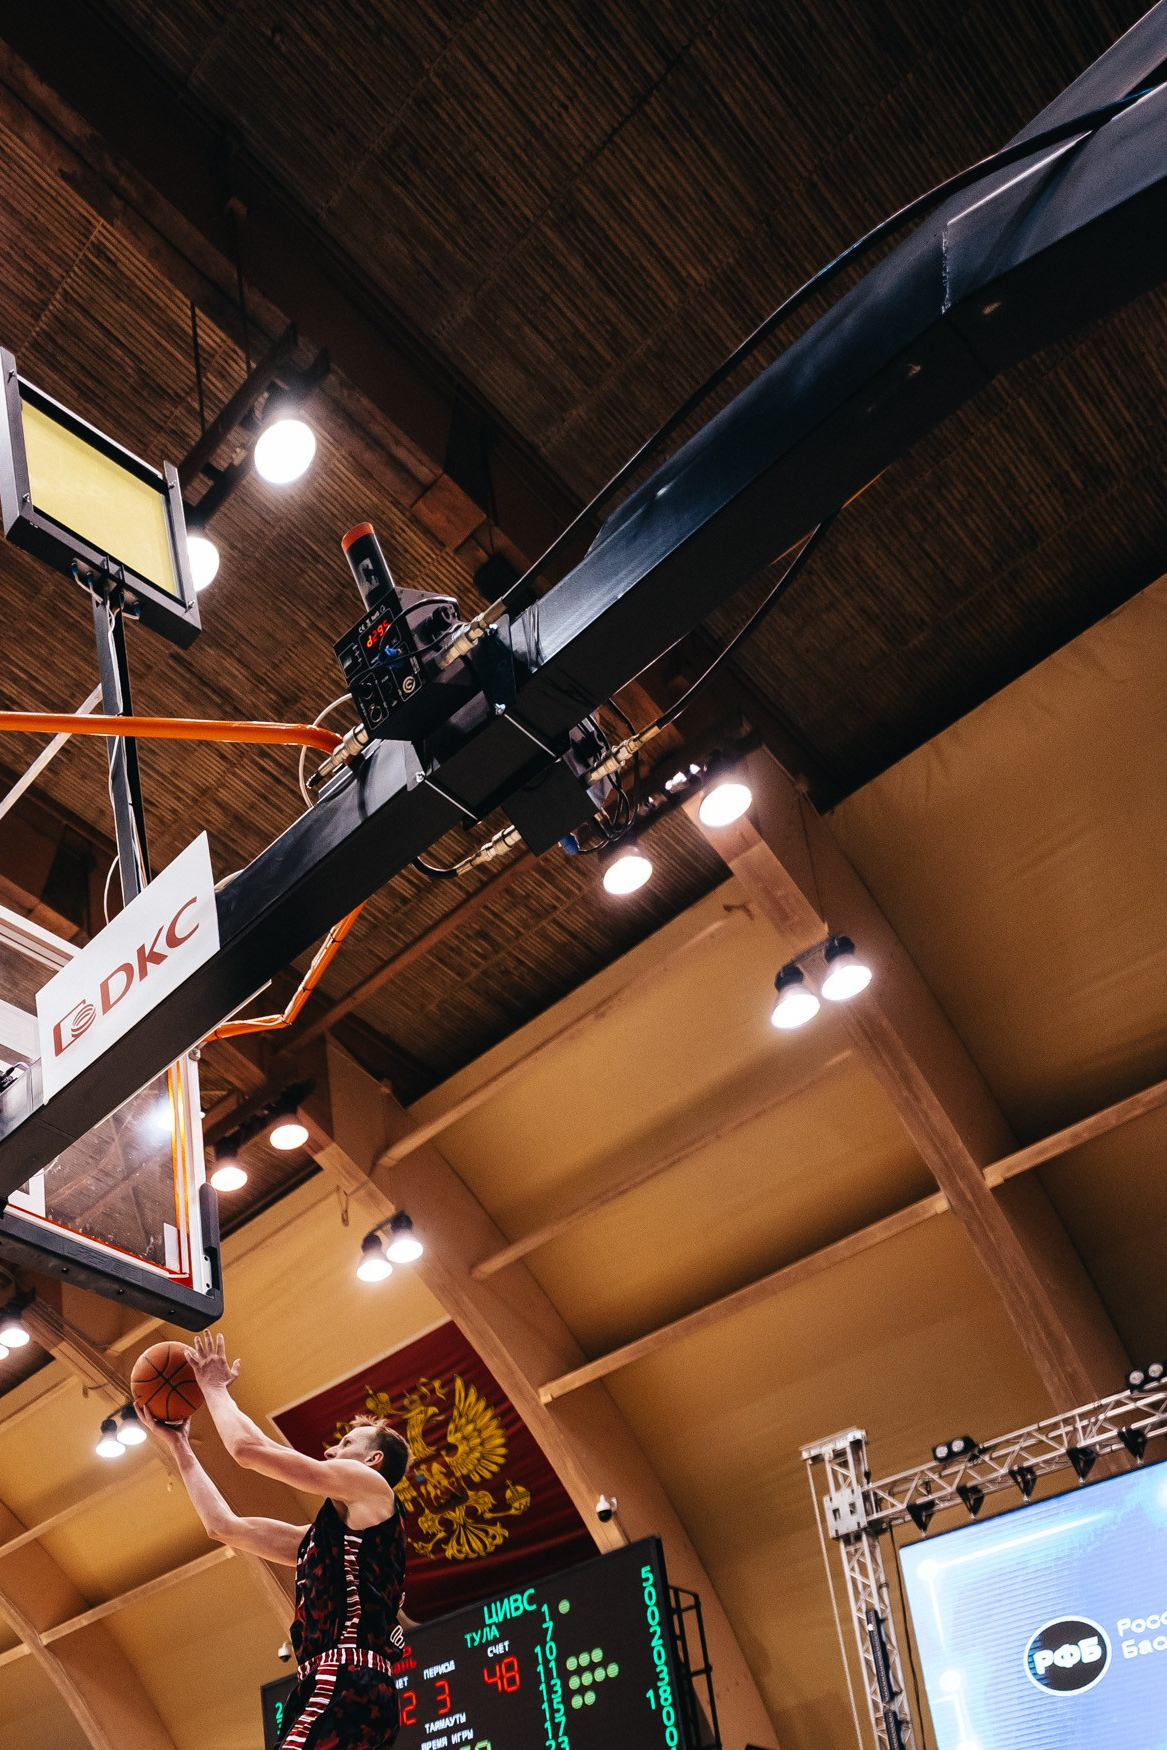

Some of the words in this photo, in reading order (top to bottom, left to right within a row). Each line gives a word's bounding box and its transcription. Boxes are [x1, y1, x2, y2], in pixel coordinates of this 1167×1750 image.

[99, 895, 200, 1016] DKC
[483, 1587, 537, 1625] ЦИВС
[541, 1603, 549, 1621] 1
[641, 1566, 654, 1587] 5
[542, 1620, 553, 1641] 7
[644, 1585, 657, 1606] 0
[464, 1624, 500, 1649] ТУЛА
[487, 1640, 510, 1658] СЧЕТ
[534, 1641, 557, 1663] 10
[647, 1605, 660, 1626] 0
[424, 1659, 456, 1680] ПЕРИОД
[537, 1660, 557, 1684] 11
[650, 1625, 663, 1647] 2
[1033, 1636, 1102, 1675] РФБ
[483, 1655, 521, 1693] 48
[539, 1678, 562, 1703] 13
[653, 1645, 666, 1666] 0
[435, 1679, 451, 1715] 3
[542, 1697, 565, 1722] 15
[656, 1665, 669, 1686] 3
[544, 1717, 566, 1740] 17
[646, 1685, 672, 1710] 18
[662, 1705, 675, 1727] 0
[451, 1728, 474, 1745] ИГРЫ
[665, 1726, 678, 1747] 0
